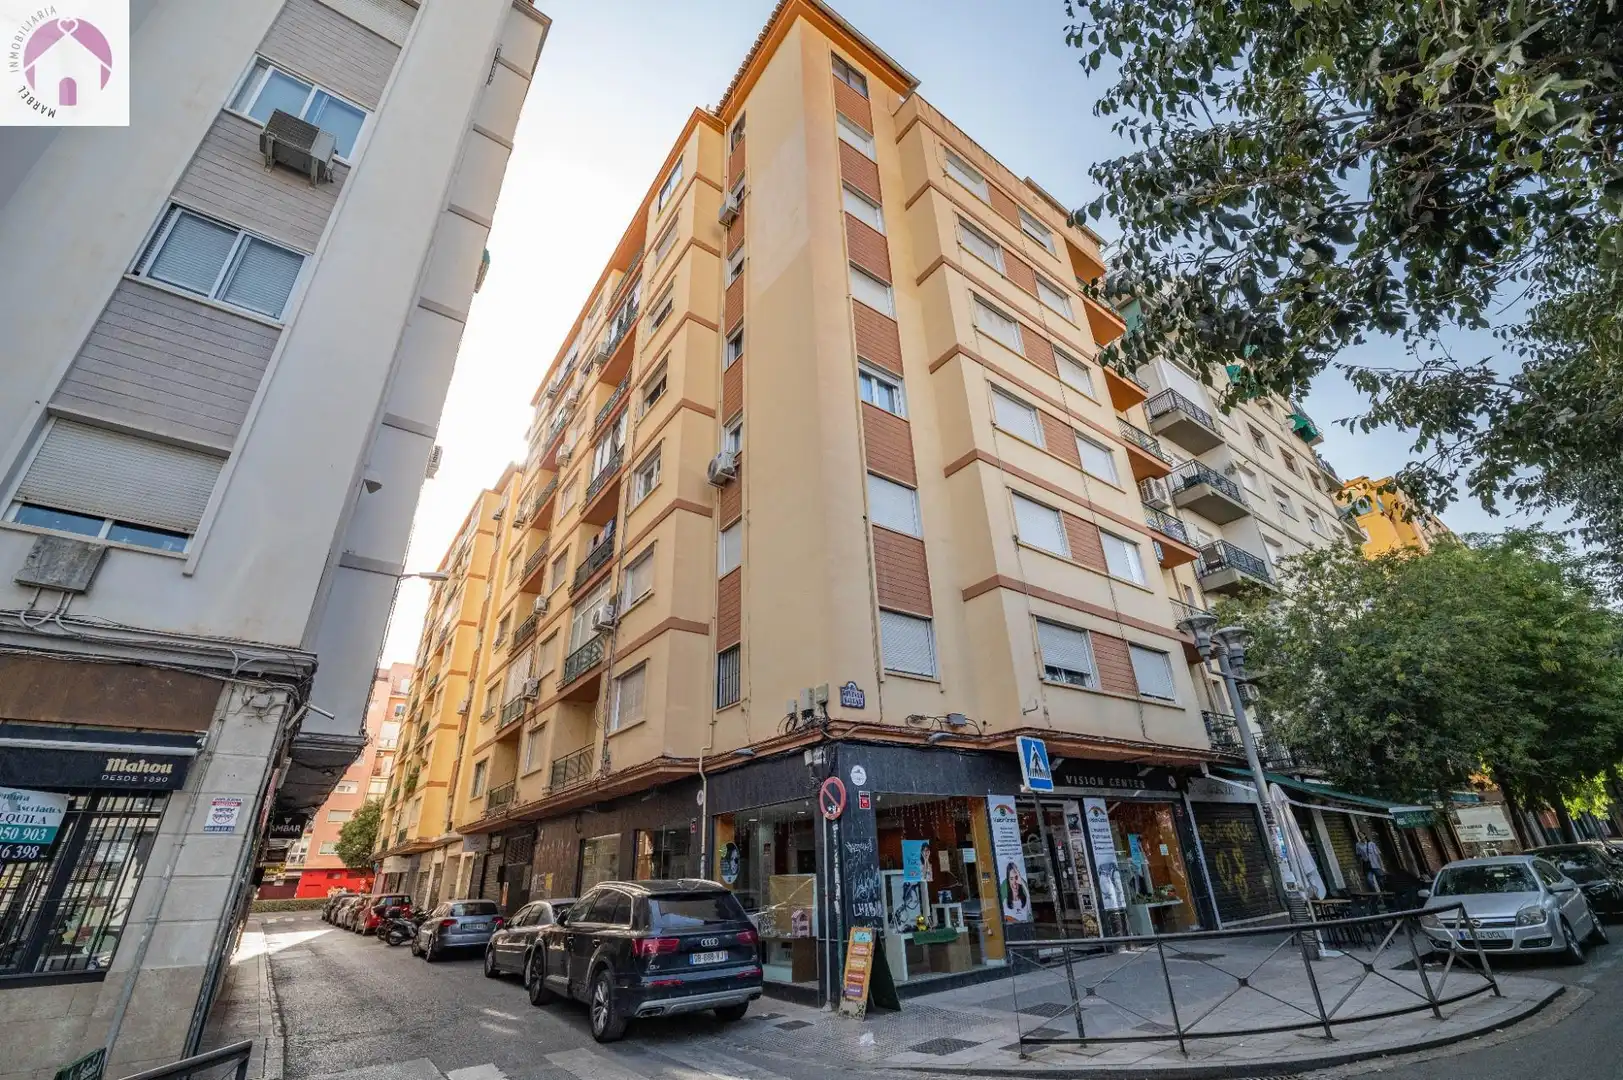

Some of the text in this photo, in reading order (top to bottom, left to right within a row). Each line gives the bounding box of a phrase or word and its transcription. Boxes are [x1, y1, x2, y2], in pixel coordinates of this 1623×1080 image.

[105, 758, 173, 773] Mahou
[101, 774, 138, 782] DESDE
[1065, 775, 1145, 789] VISION CENTER
[22, 827, 48, 841] 903
[12, 844, 40, 859] 398
